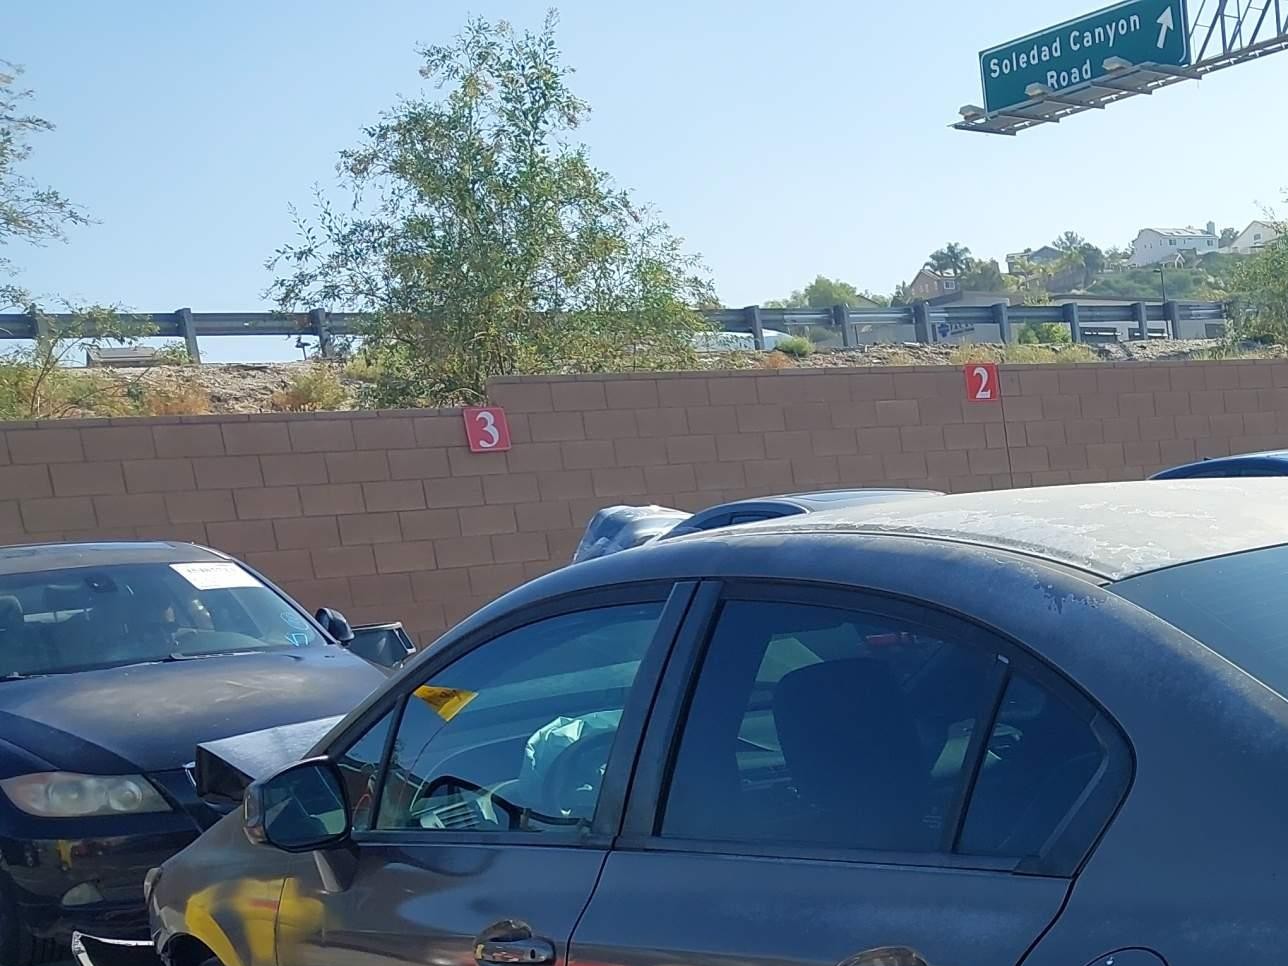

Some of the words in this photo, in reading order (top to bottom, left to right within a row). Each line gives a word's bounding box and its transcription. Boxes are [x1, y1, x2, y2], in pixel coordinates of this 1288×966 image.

[990, 36, 1061, 78] Soledad
[1070, 14, 1140, 51] Canyon
[1047, 59, 1092, 89] Road
[973, 367, 991, 399] 2
[476, 411, 499, 447] 3
